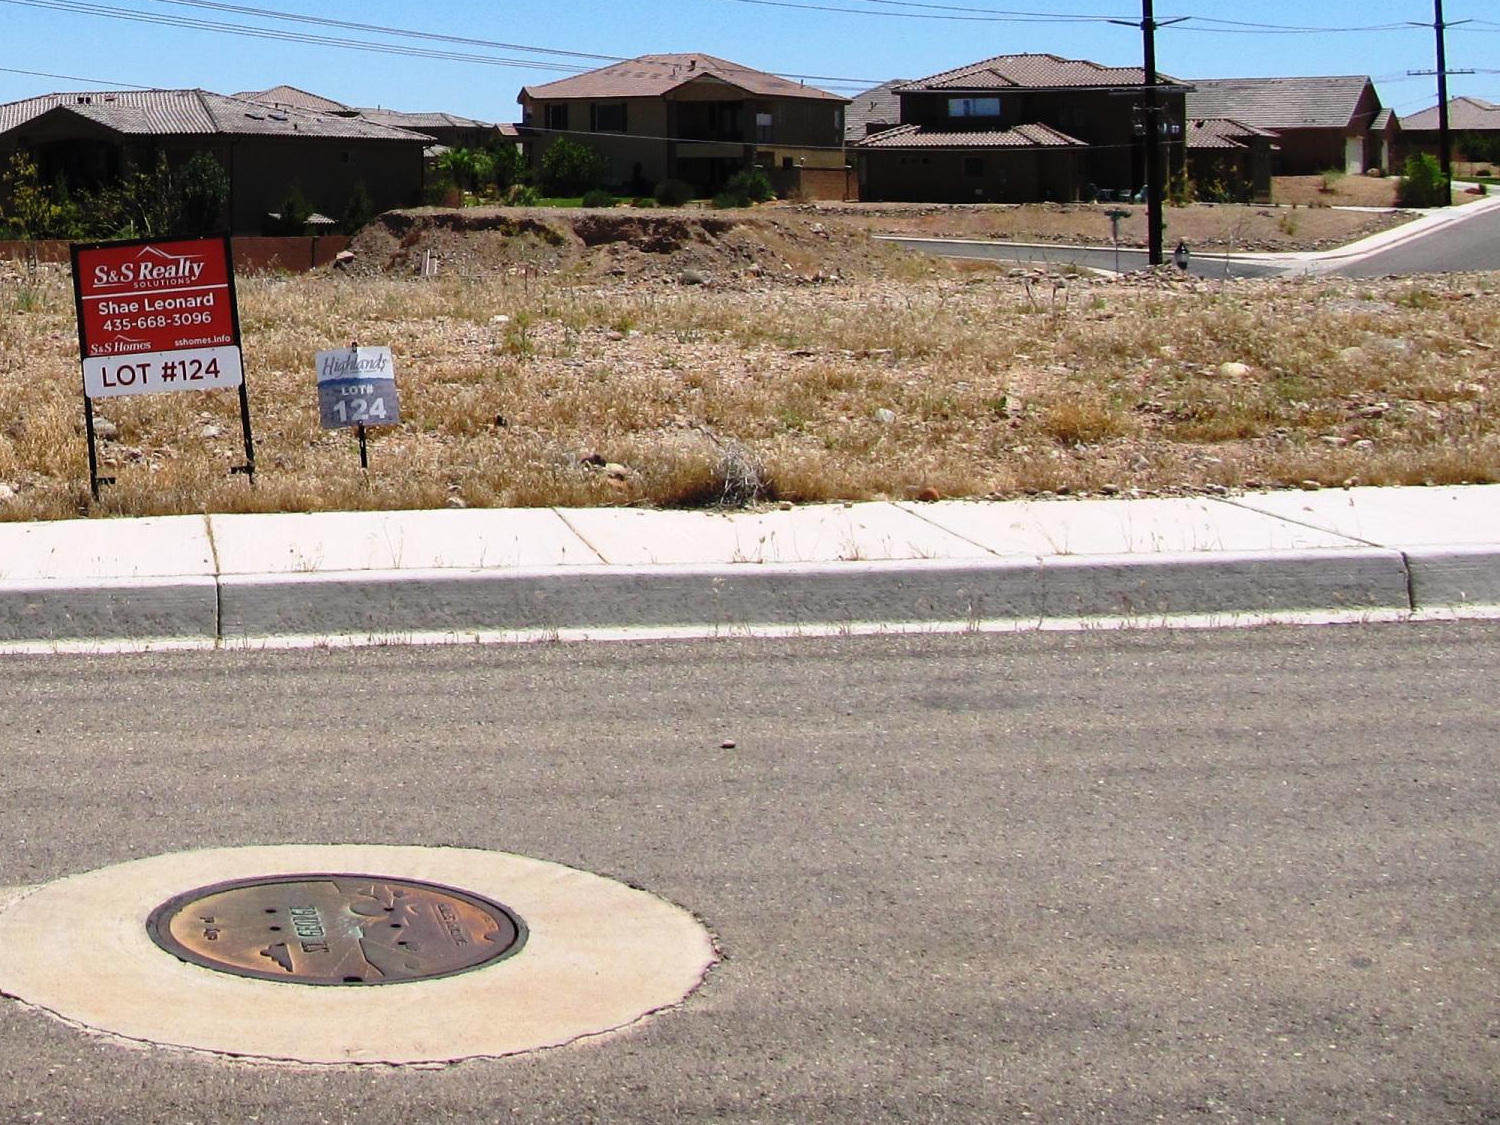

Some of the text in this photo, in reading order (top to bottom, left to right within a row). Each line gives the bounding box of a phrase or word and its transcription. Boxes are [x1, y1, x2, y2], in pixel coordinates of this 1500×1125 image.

[94, 258, 205, 285] S&S Realty
[133, 277, 191, 289] SOLUTIONS
[98, 293, 214, 316] Shae Leonard
[103, 311, 212, 332] 435-668-3096
[90, 340, 152, 355] S&S Homes
[174, 334, 232, 347] sshomes.info
[101, 357, 221, 387] LOT #124
[323, 353, 387, 377] Highlands
[342, 383, 374, 396] LOT#
[333, 397, 387, 423] 124
